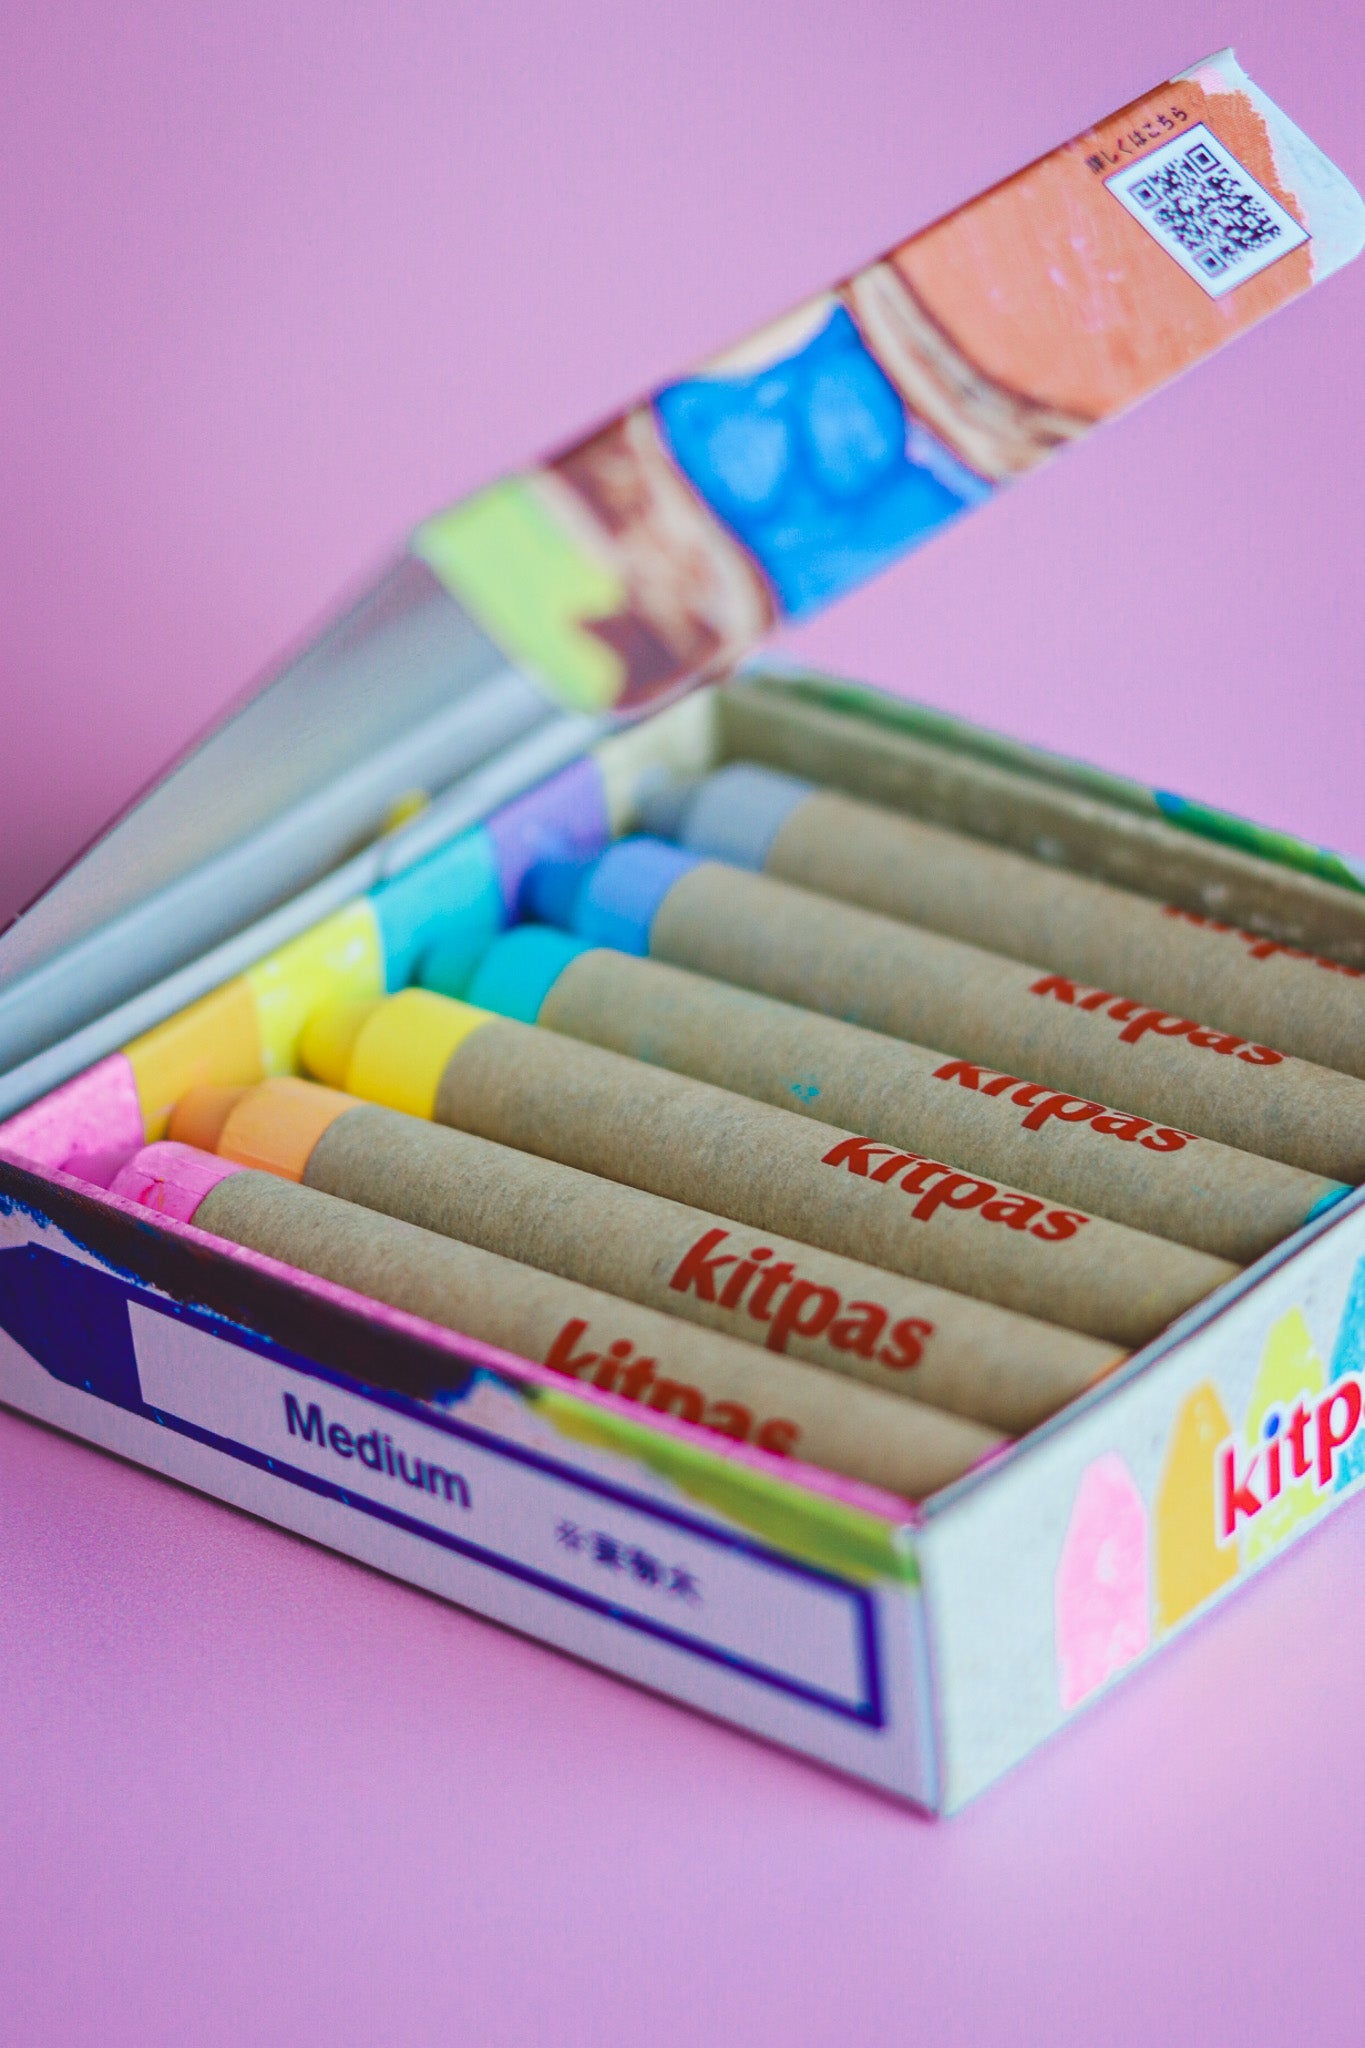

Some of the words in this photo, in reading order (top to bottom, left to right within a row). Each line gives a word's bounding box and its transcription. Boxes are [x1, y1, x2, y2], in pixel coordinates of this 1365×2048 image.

[1085, 106, 1188, 175] しくはこちら
[821, 1136, 1092, 1242] kitpas
[668, 1228, 935, 1371] kitpas
[282, 1392, 473, 1509] Medium
[1222, 1380, 1365, 1538] kitp
